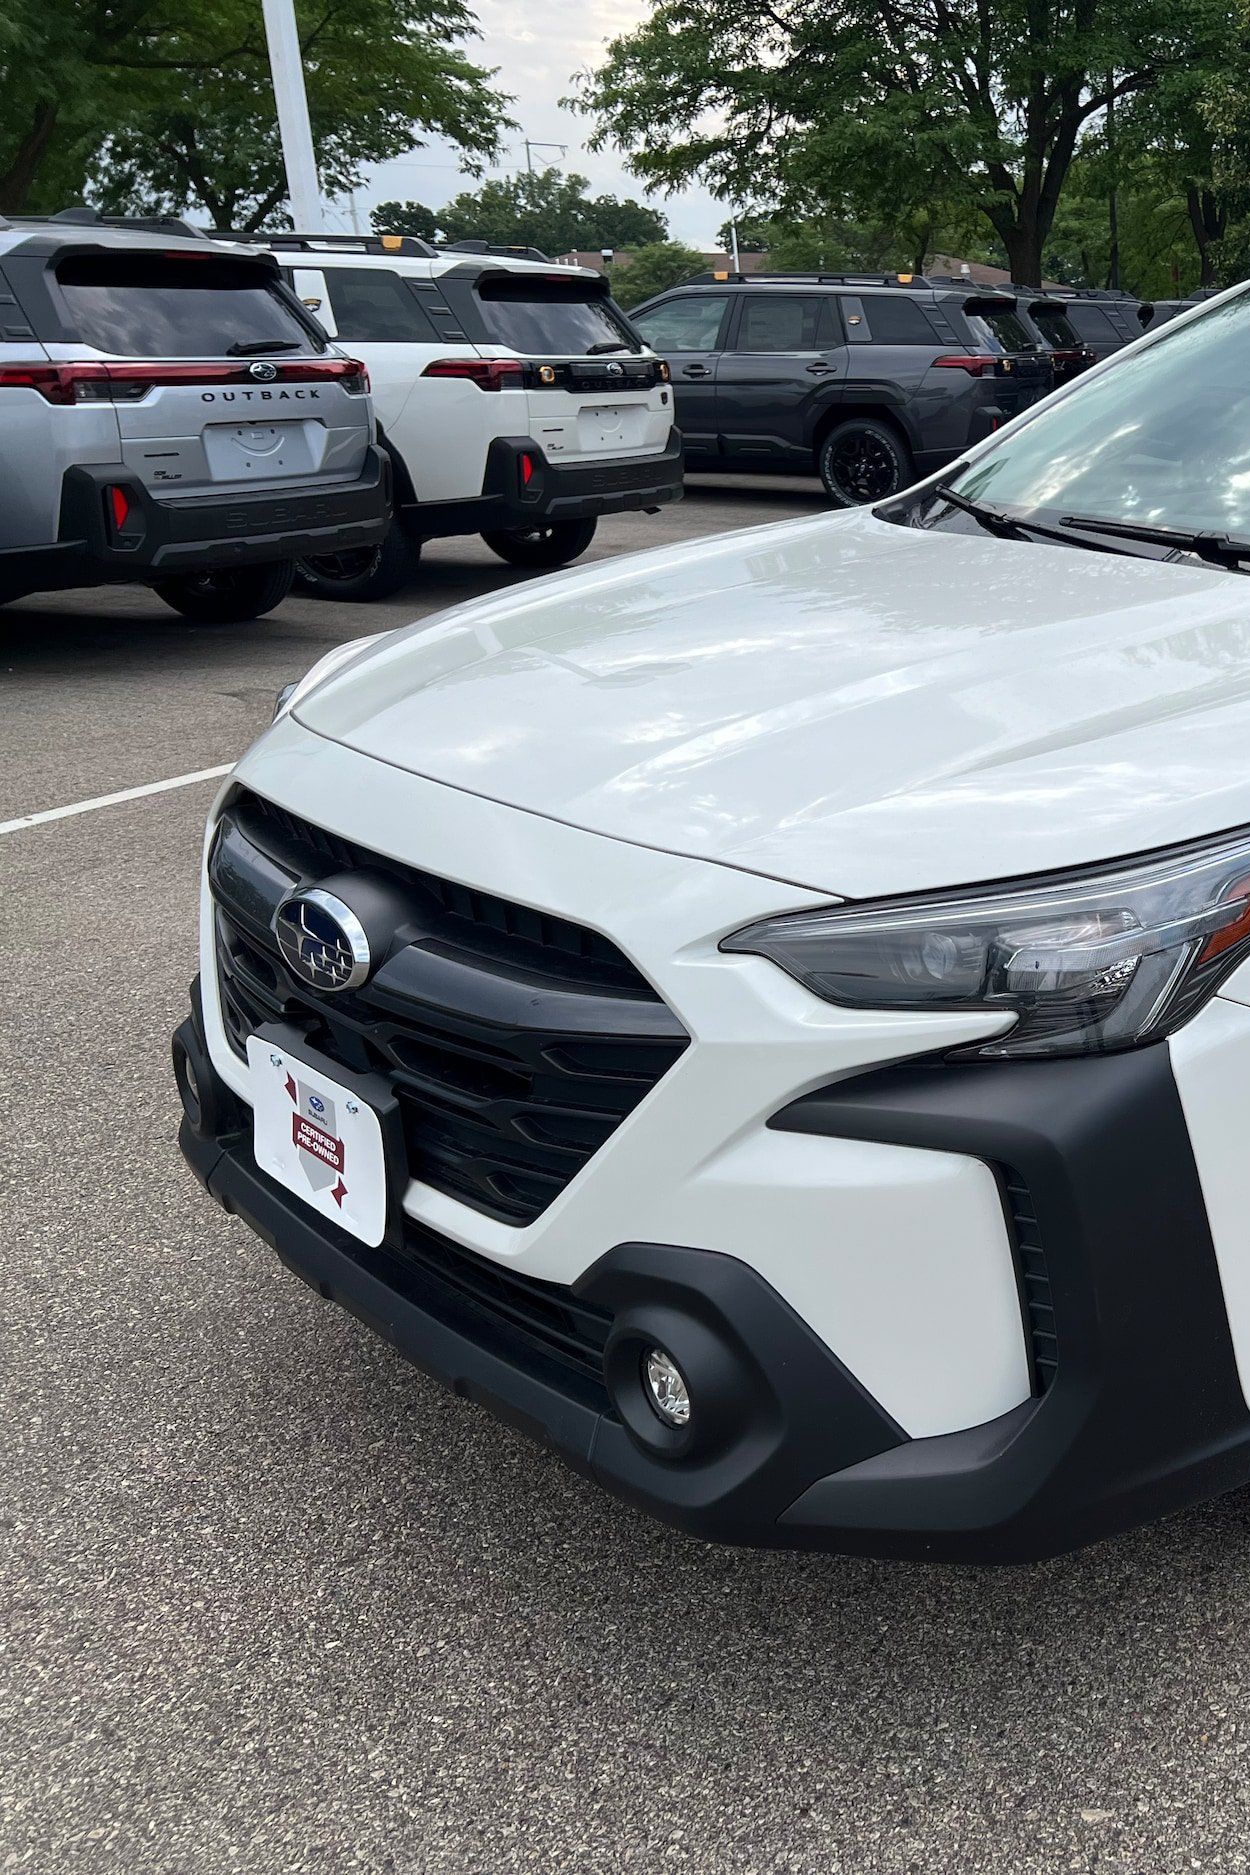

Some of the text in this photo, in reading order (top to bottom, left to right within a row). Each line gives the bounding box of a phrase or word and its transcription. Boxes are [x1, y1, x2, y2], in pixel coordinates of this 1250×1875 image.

[201, 389, 321, 402] OUTBACK
[307, 1109, 328, 1126] SUBARU
[297, 1131, 340, 1166] PRE-OWNED
[300, 1122, 337, 1152] CERTIFIED
